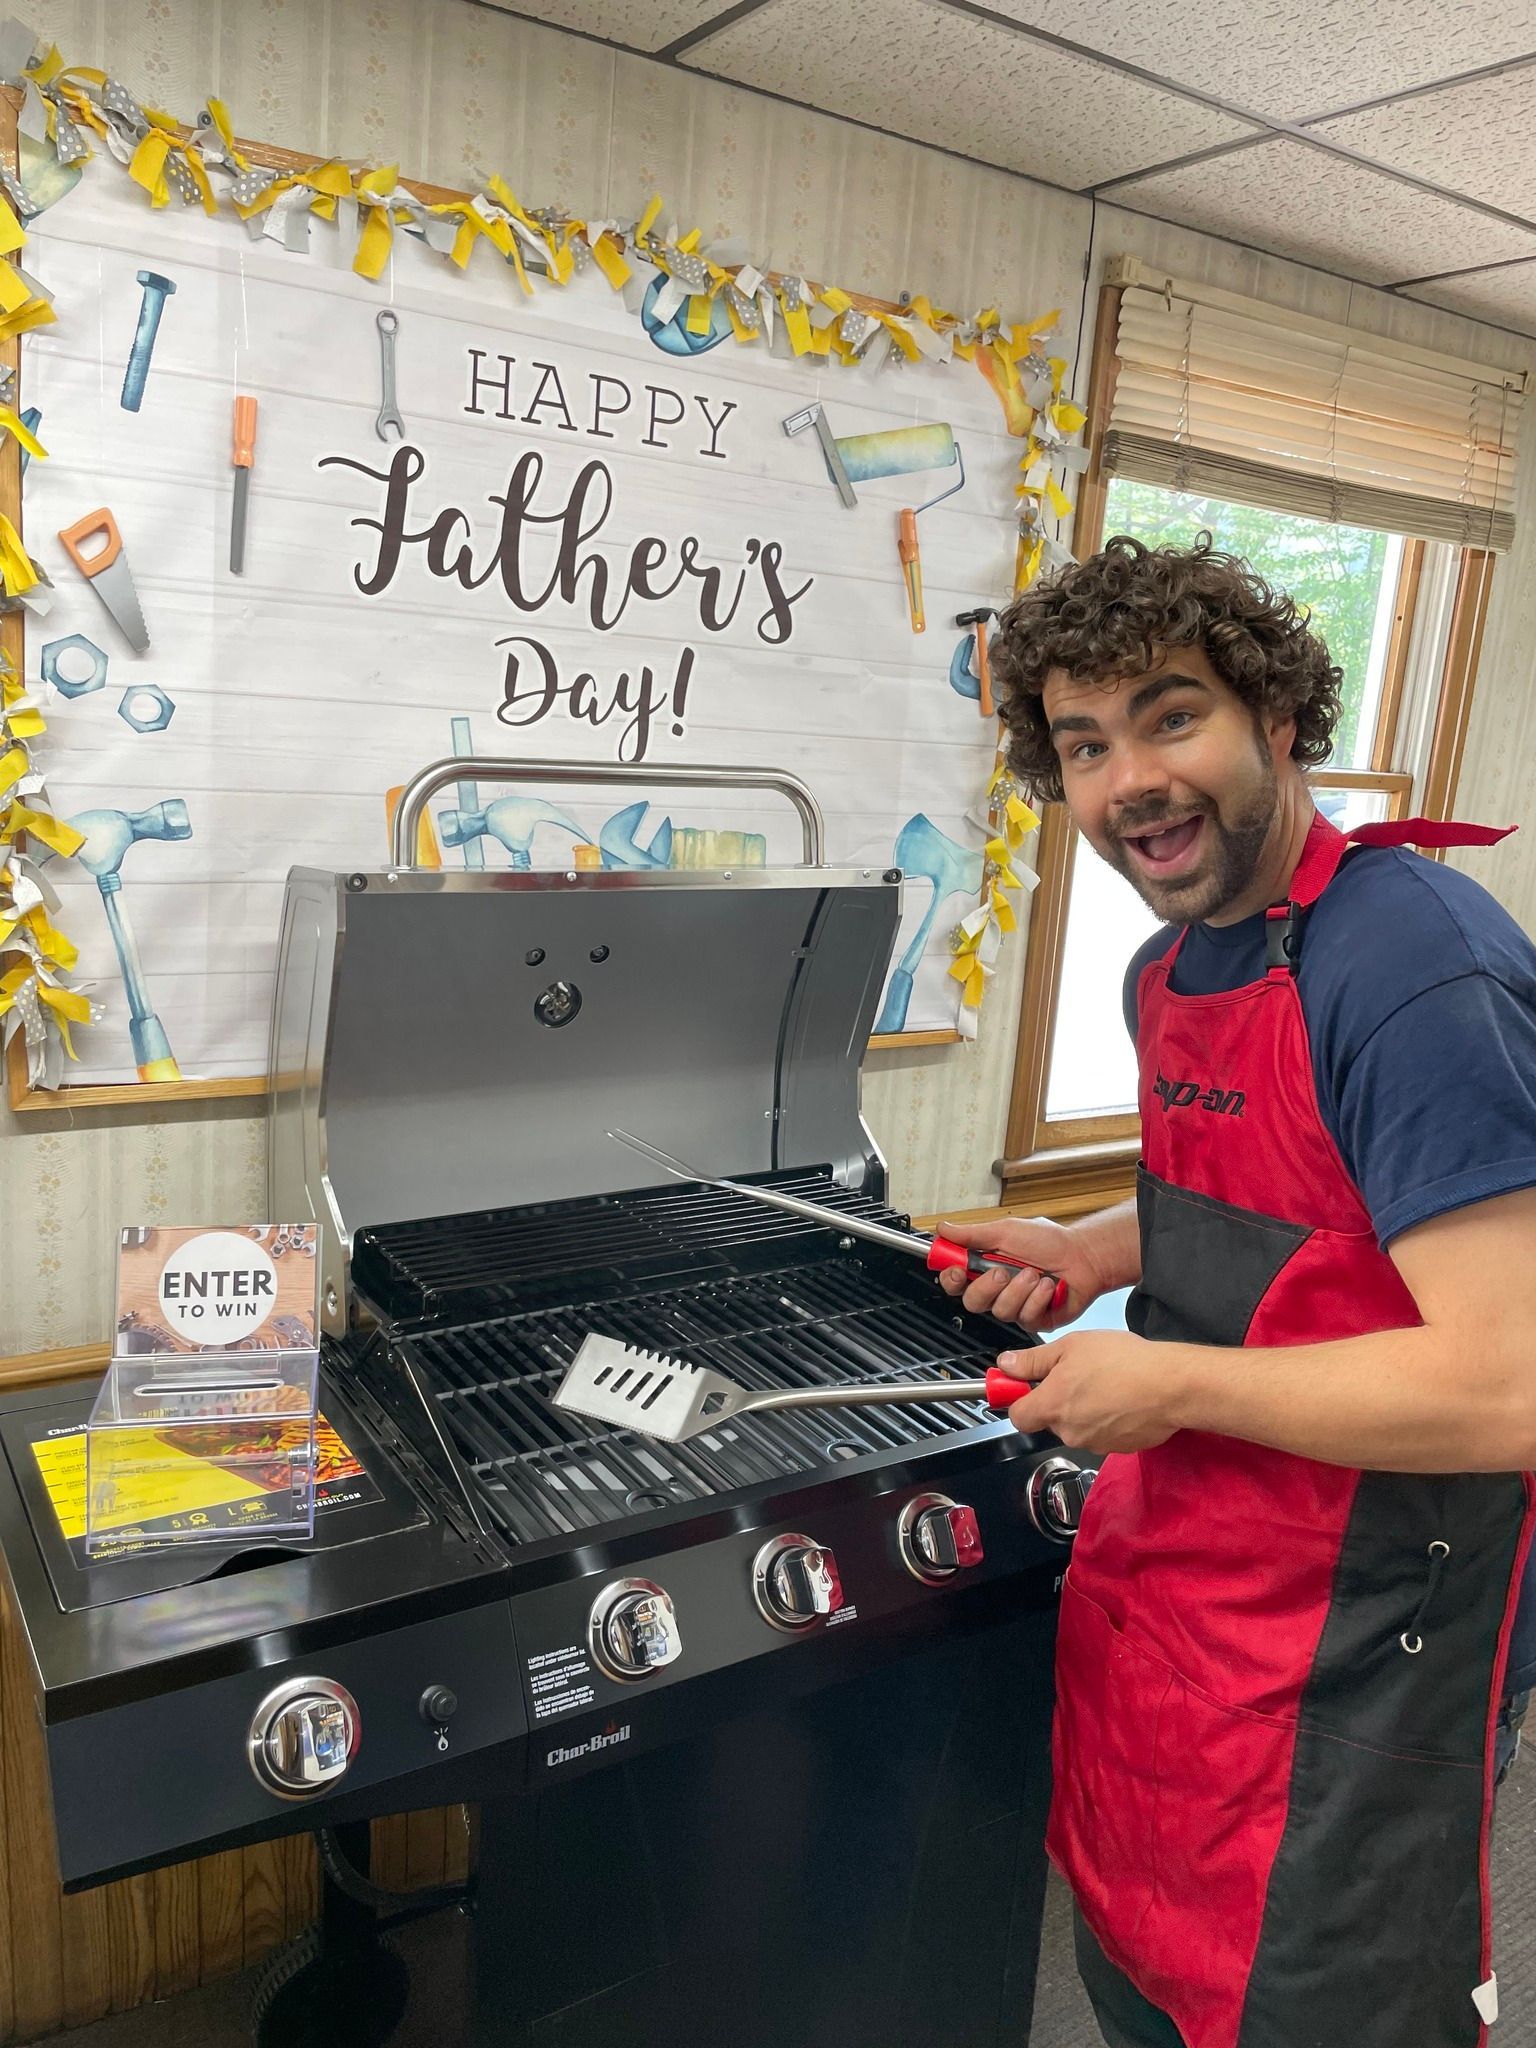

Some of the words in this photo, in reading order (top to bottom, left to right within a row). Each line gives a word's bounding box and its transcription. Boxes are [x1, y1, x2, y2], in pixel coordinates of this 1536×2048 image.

[464, 349, 737, 459] HAPPY
[318, 445, 813, 644] Father's
[494, 636, 695, 762] Day!
[163, 1269, 274, 1299] ENTER
[178, 1304, 205, 1318] TO
[216, 1303, 257, 1317] WIN
[547, 1724, 631, 1767] Char-Broil
